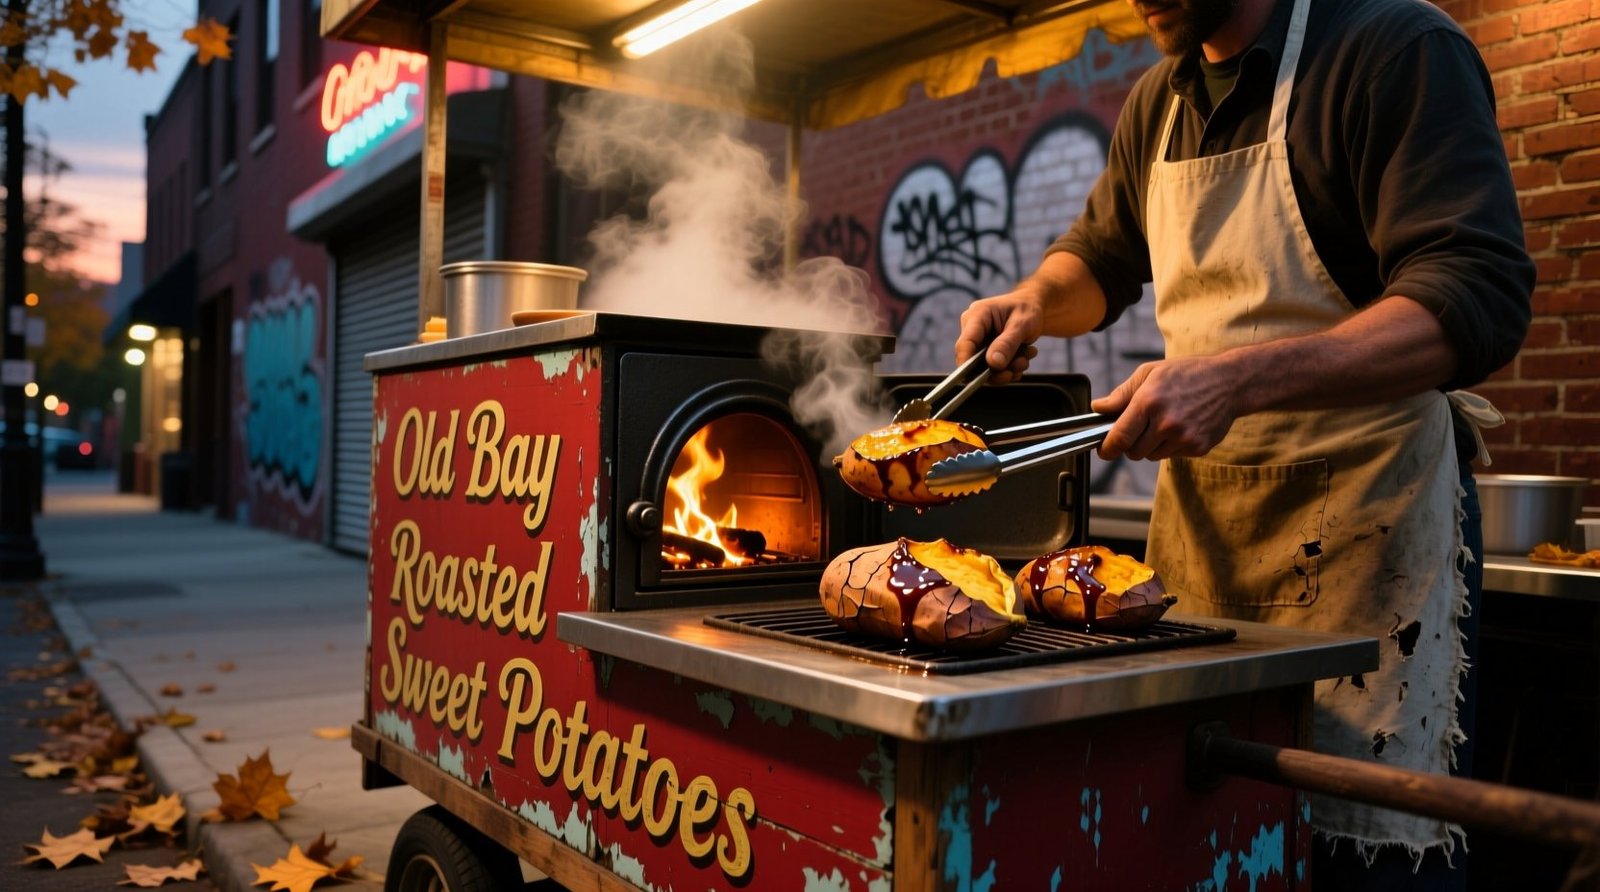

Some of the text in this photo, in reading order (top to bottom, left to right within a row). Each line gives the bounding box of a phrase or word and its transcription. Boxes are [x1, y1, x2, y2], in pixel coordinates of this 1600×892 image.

[394, 400, 560, 530] Old Bay
[390, 520, 553, 636] Roasted
[380, 618, 755, 877] Sweet Potatoes
